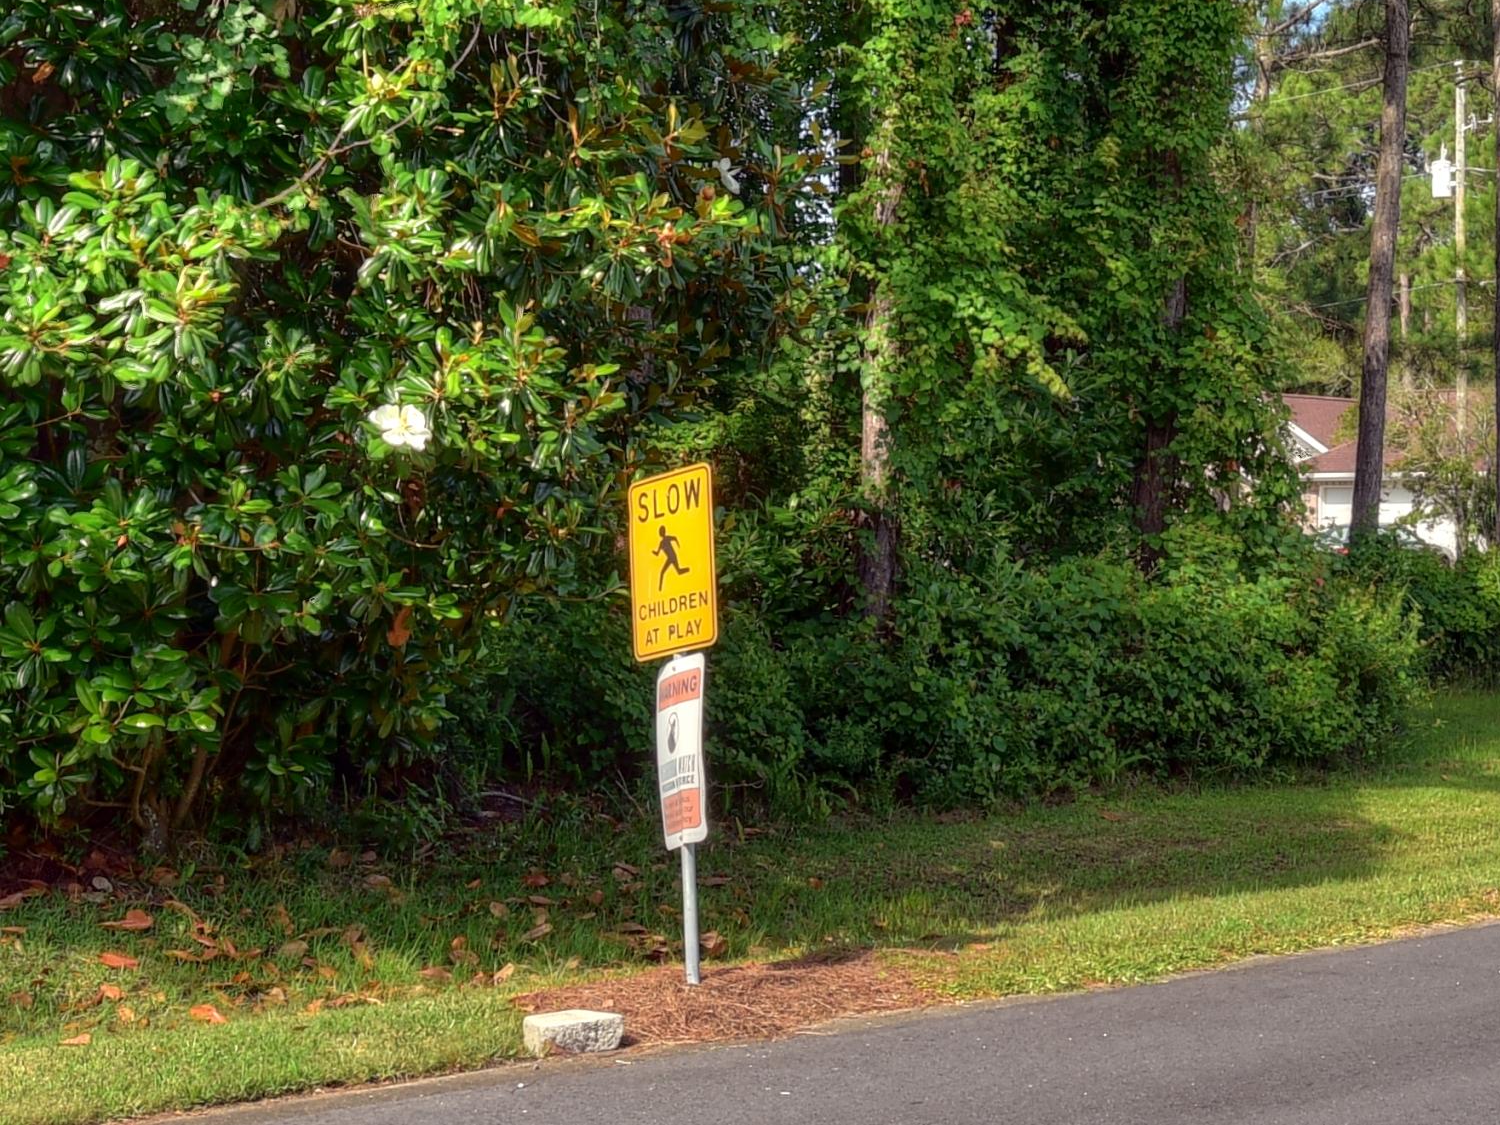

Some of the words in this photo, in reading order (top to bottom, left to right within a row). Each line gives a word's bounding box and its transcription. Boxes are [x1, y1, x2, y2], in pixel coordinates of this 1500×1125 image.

[638, 477, 701, 523] SLOW
[639, 590, 708, 621] CHILDREN
[645, 627, 660, 647] AT
[668, 618, 703, 641] PLAY
